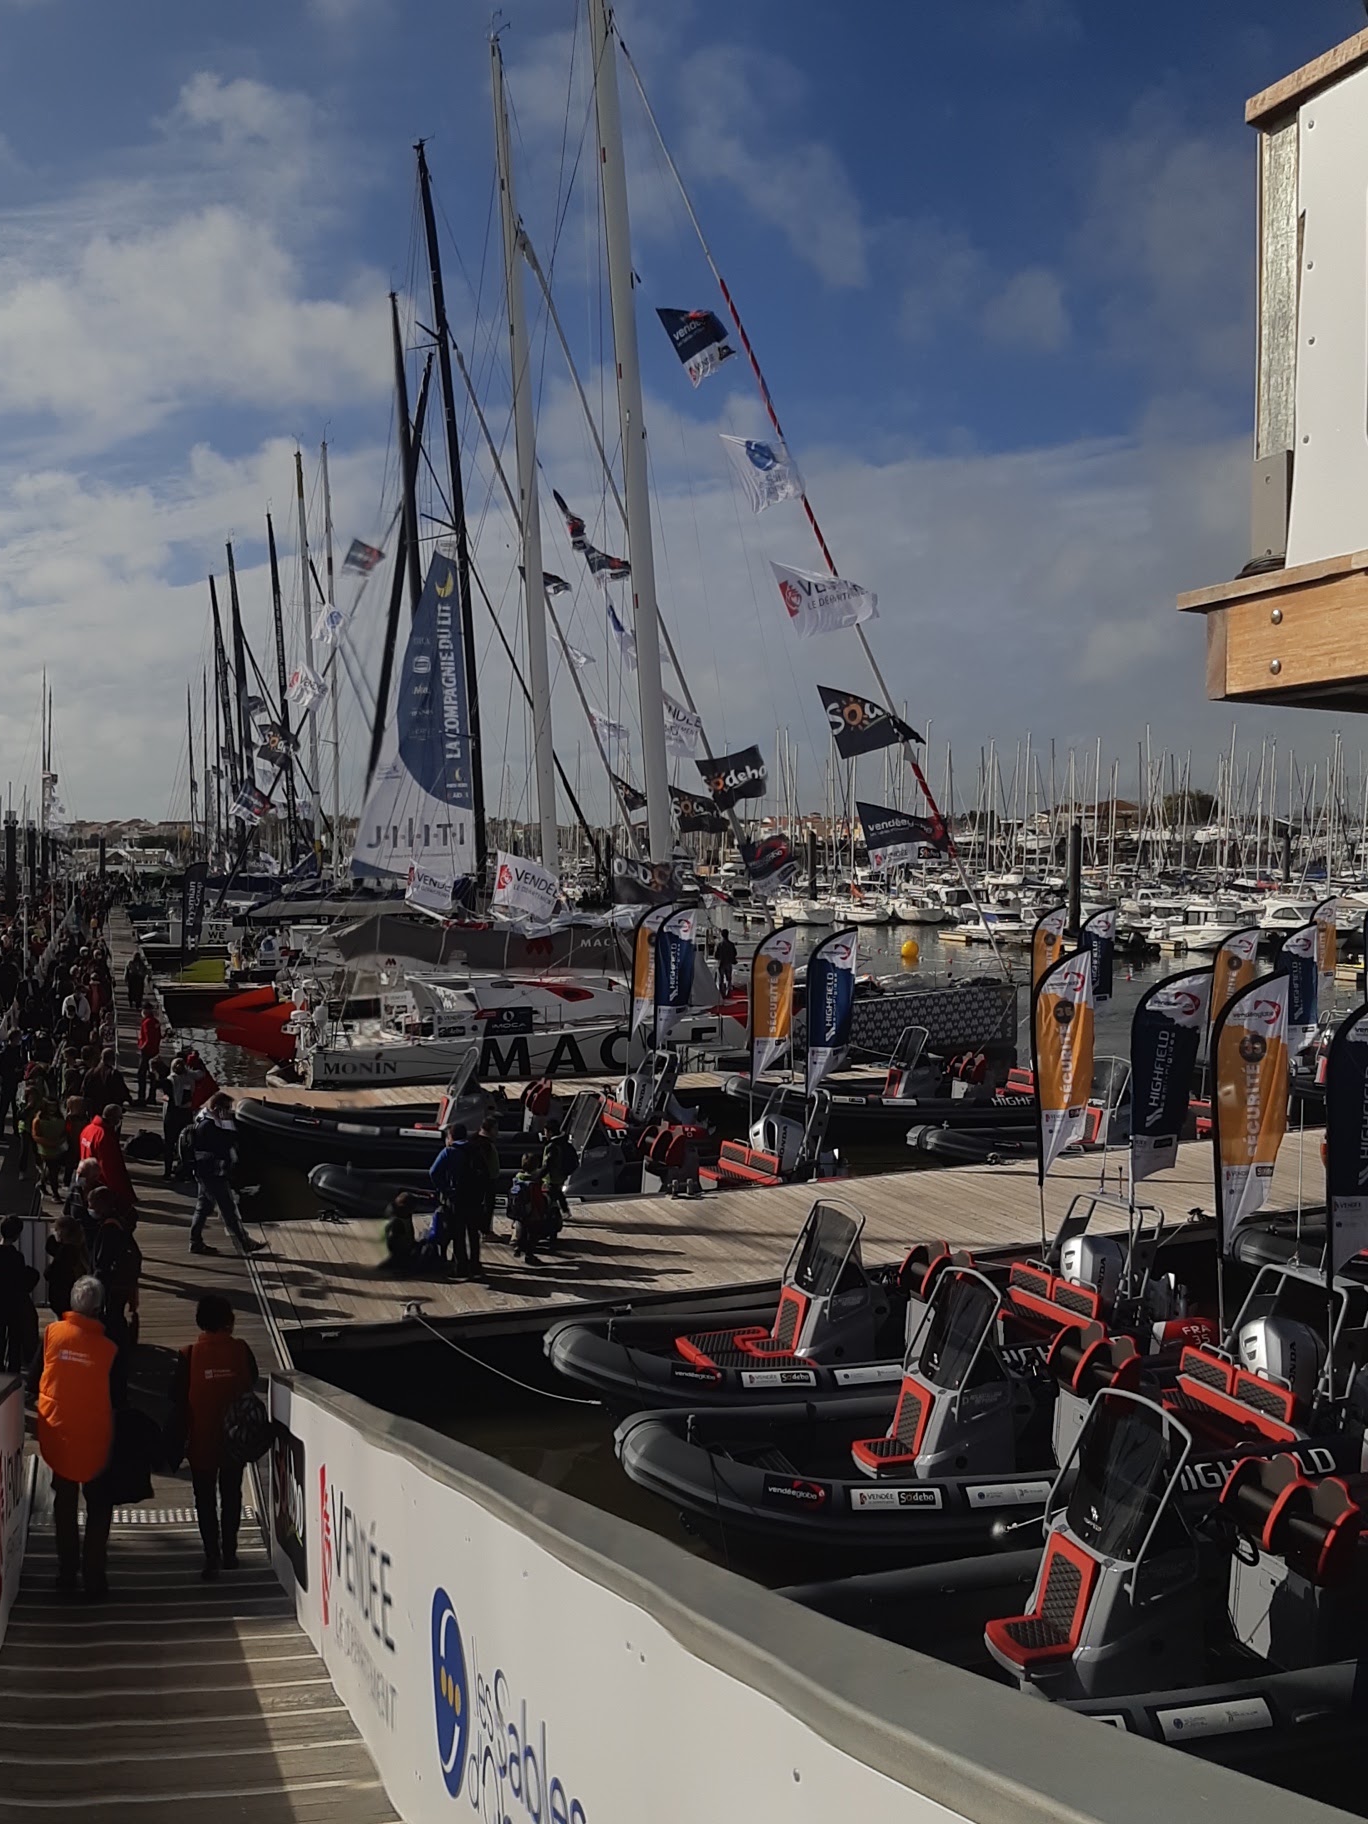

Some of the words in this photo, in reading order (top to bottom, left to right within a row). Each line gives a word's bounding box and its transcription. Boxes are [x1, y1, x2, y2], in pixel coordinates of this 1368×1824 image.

[438, 604, 452, 627] LIT
[438, 629, 453, 647] DU
[440, 651, 459, 737] COMPAGNIE
[446, 738, 462, 759] LA
[208, 923, 227, 931] YES
[208, 931, 225, 939] WE
[769, 975, 779, 1034] SÉCURITÉ
[825, 972, 835, 1028] HIGHFIELD
[323, 1060, 398, 1075] MONIN
[1148, 1030, 1171, 1107] HIGHFIELD
[636, 1083, 647, 1115] HONDA
[1247, 1061, 1261, 1158] SÉCURITÉ
[1182, 1324, 1212, 1337] FRA
[1193, 1334, 1211, 1344] 35
[768, 1485, 818, 1501] vendéeglobe
[899, 1491, 935, 1503] Sodebo
